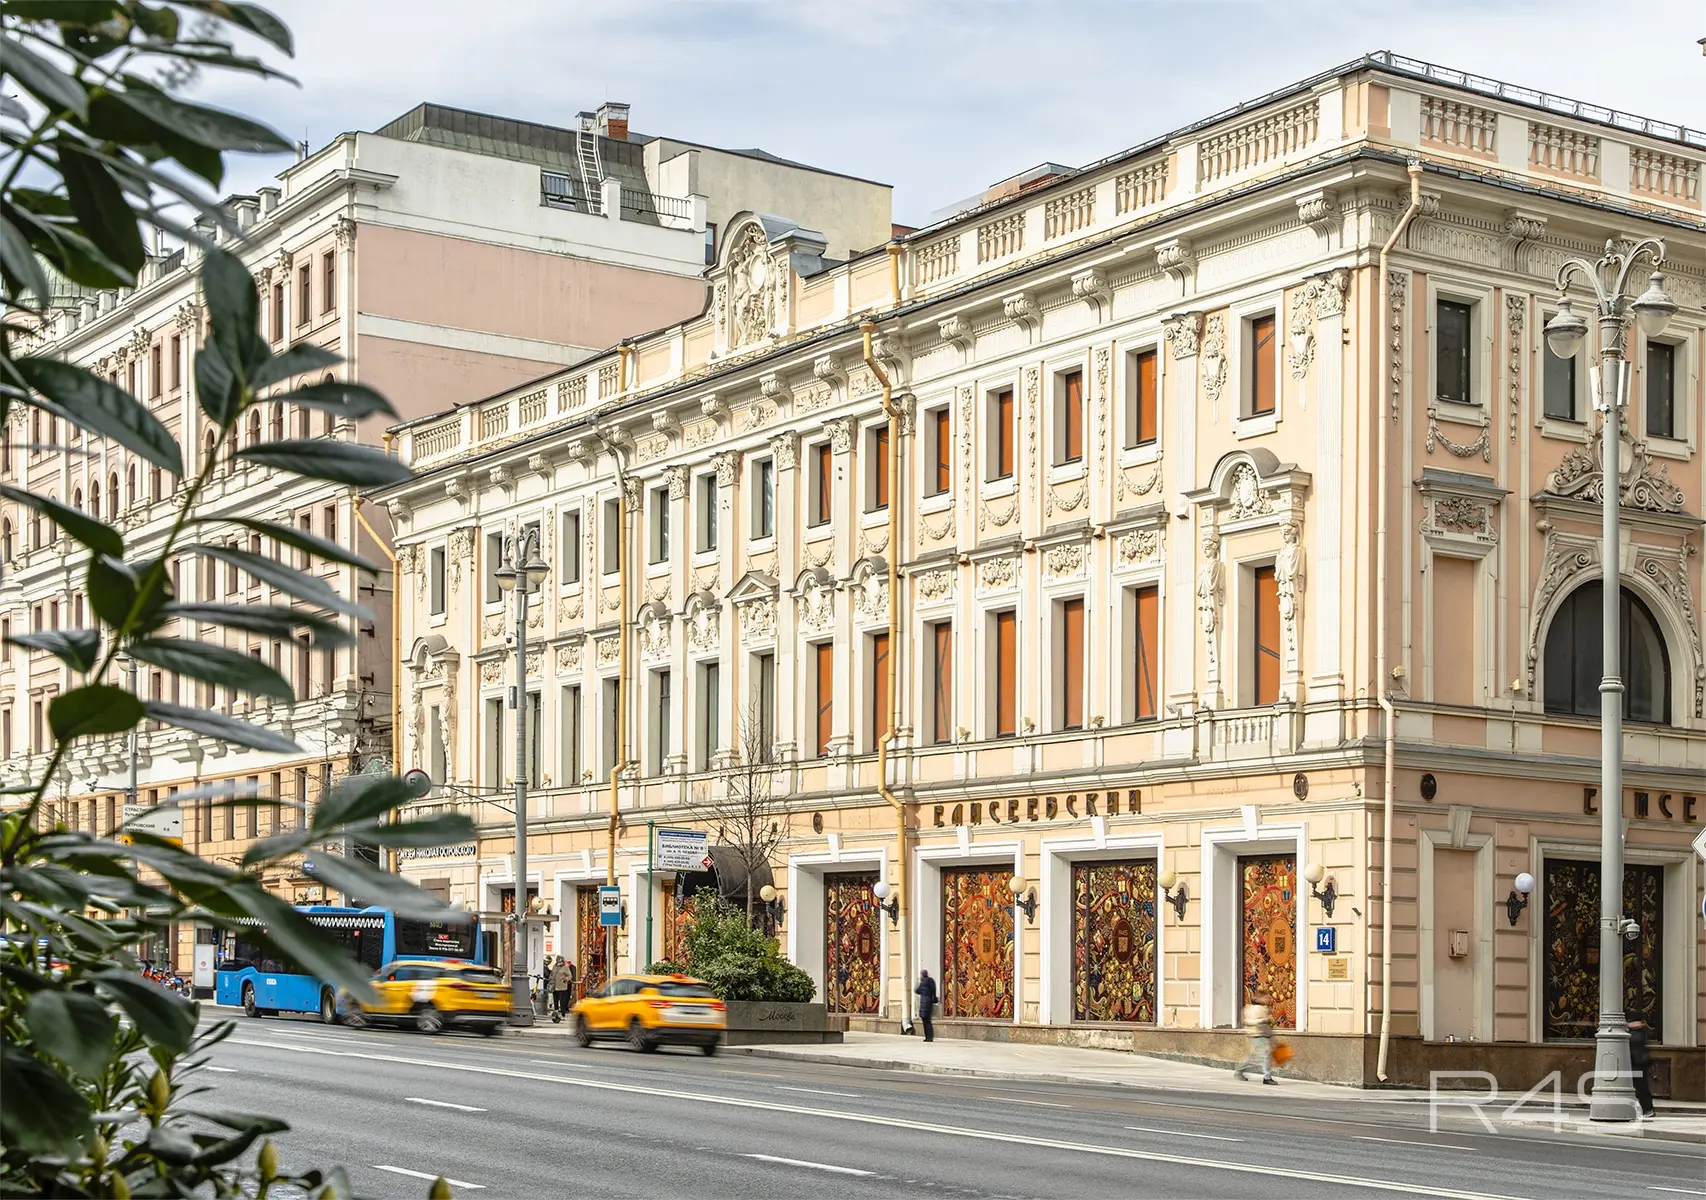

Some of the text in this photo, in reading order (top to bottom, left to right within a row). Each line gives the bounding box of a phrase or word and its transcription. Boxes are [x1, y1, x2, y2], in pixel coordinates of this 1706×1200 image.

[1583, 787, 1697, 823] ЕИСЕ
[1319, 933, 1329, 946] 14
[758, 1011, 796, 1022] Москва
